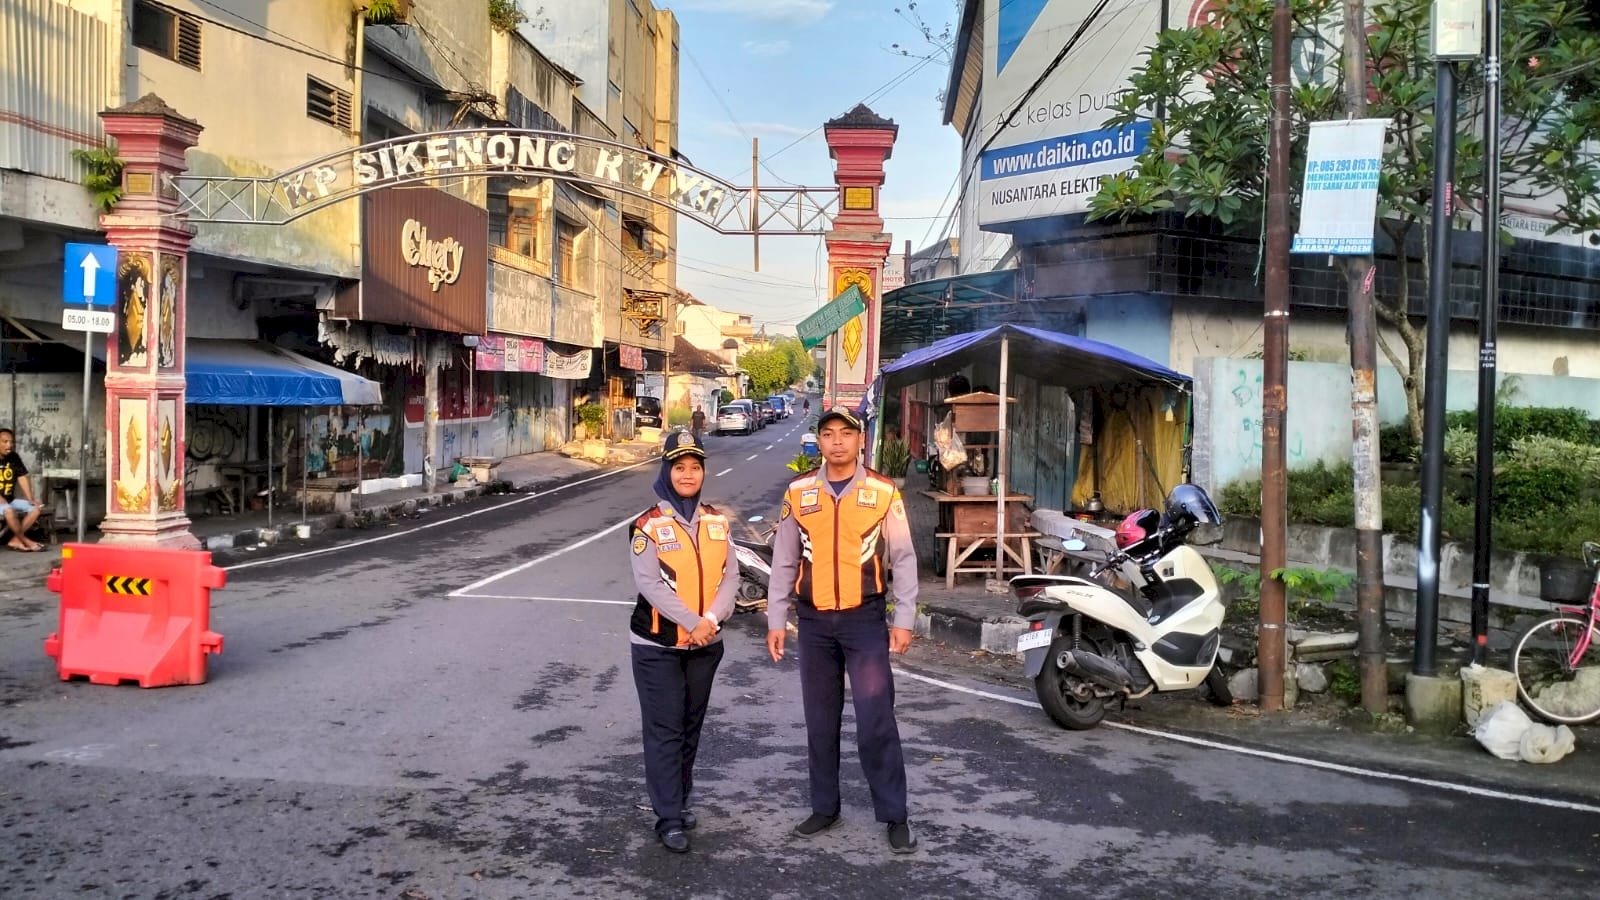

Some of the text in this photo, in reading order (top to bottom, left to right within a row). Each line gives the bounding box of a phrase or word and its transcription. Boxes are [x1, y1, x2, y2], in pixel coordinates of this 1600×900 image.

[995, 86, 1126, 131] AC kelas Duni
[353, 134, 576, 185] SIKENONG
[993, 130, 1135, 175] www.daikin.co.id
[991, 183, 1057, 206] NUSANTARA
[67, 315, 86, 324] 05.00
[92, 316, 110, 326] 18.00
